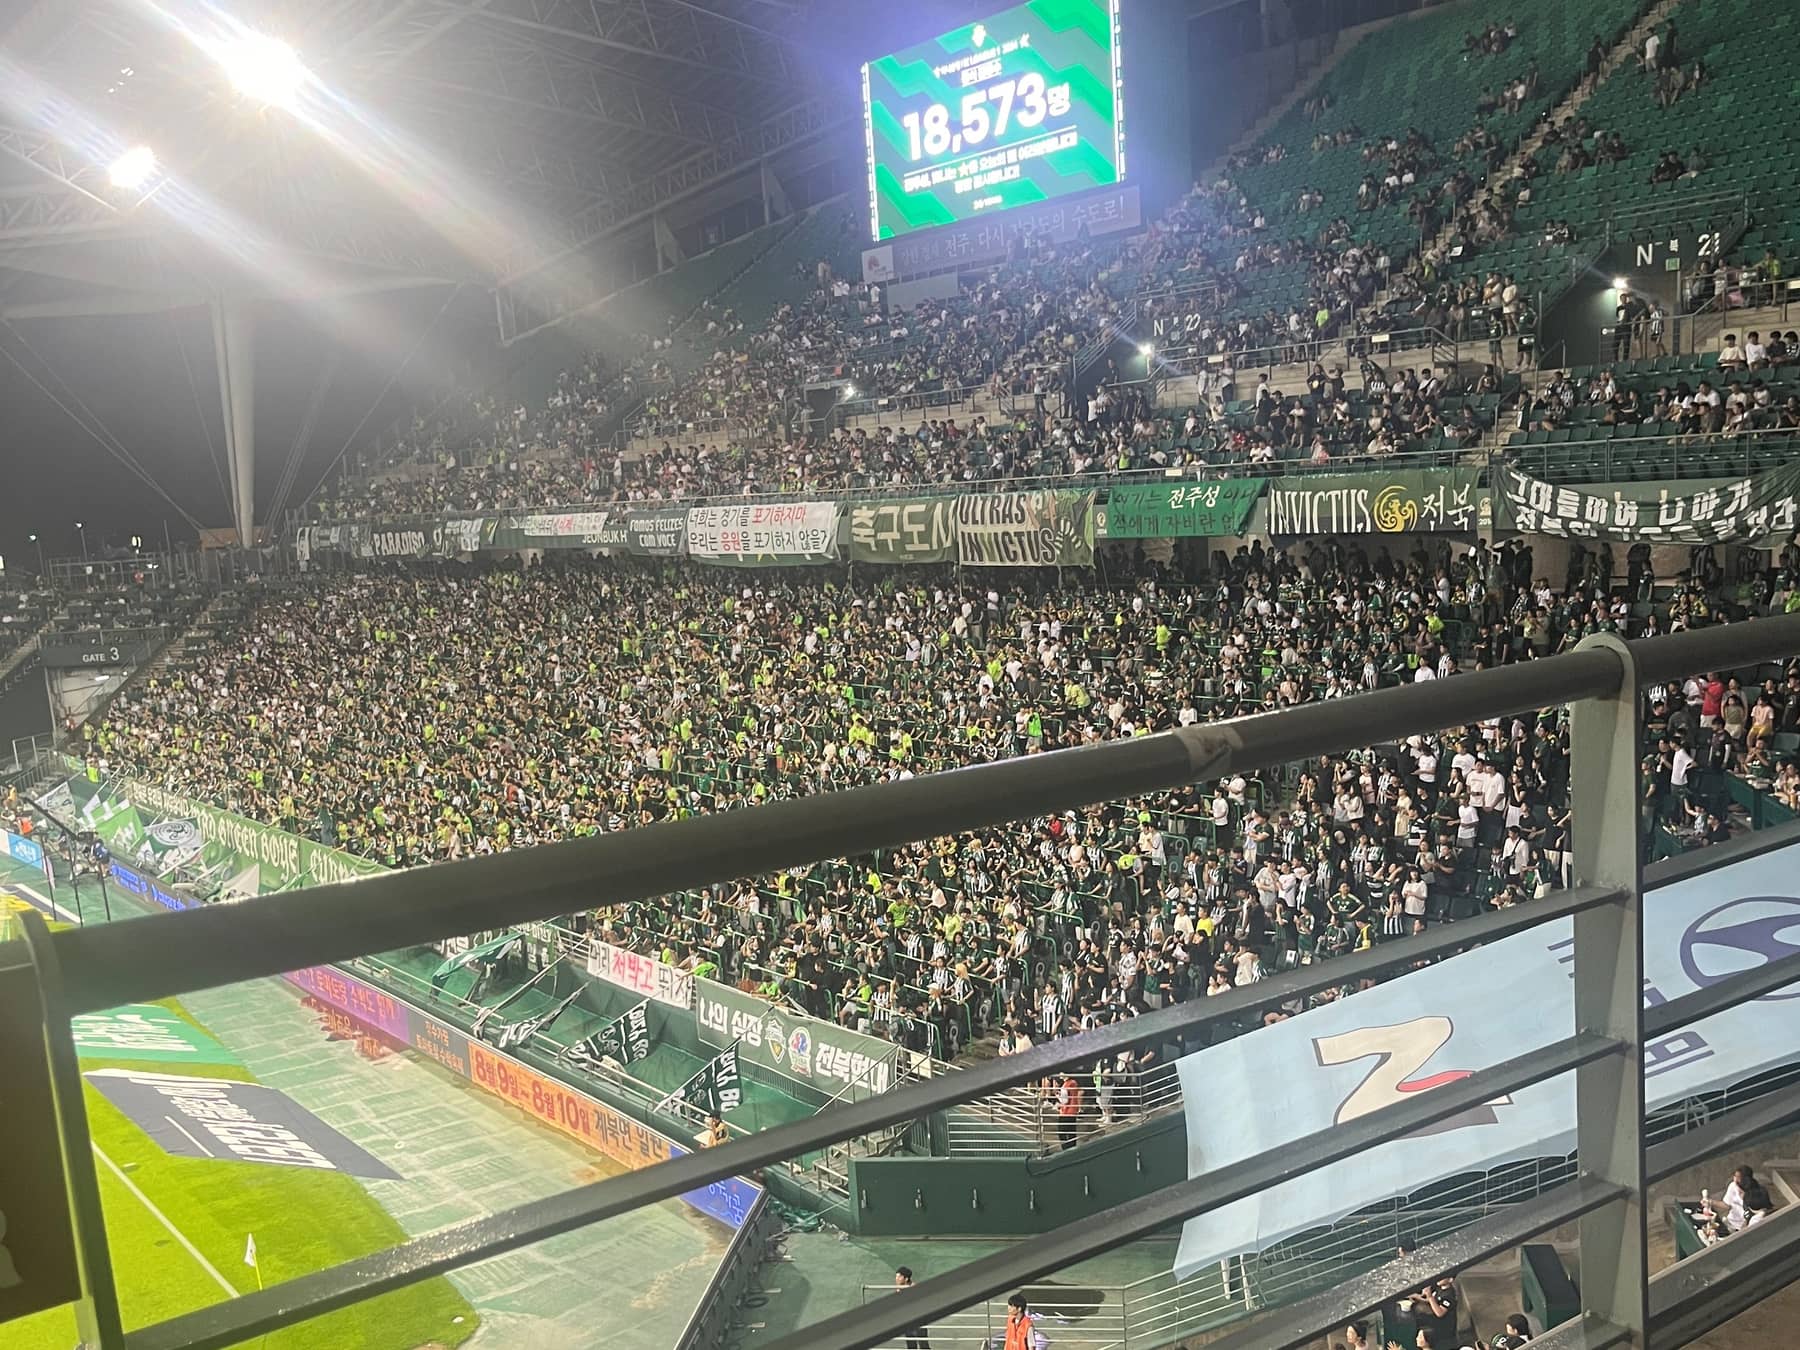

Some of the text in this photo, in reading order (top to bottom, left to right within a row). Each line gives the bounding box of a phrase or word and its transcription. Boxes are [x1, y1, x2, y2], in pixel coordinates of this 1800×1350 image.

[903, 72, 1071, 161] 18,573명
[1185, 313, 1201, 332] 22
[689, 509, 718, 528] 너희는
[720, 507, 750, 527] 경기를
[958, 494, 1027, 526] ULTRAS
[1269, 488, 1372, 535] INVICTUS
[1420, 483, 1476, 532] 전북
[689, 532, 718, 552] 우리는
[720, 530, 750, 552] 응원을
[960, 527, 1057, 565] INVICTUS
[82, 646, 120, 663] GATE 3
[699, 997, 728, 1036] 나의
[731, 1007, 765, 1048] 심장
